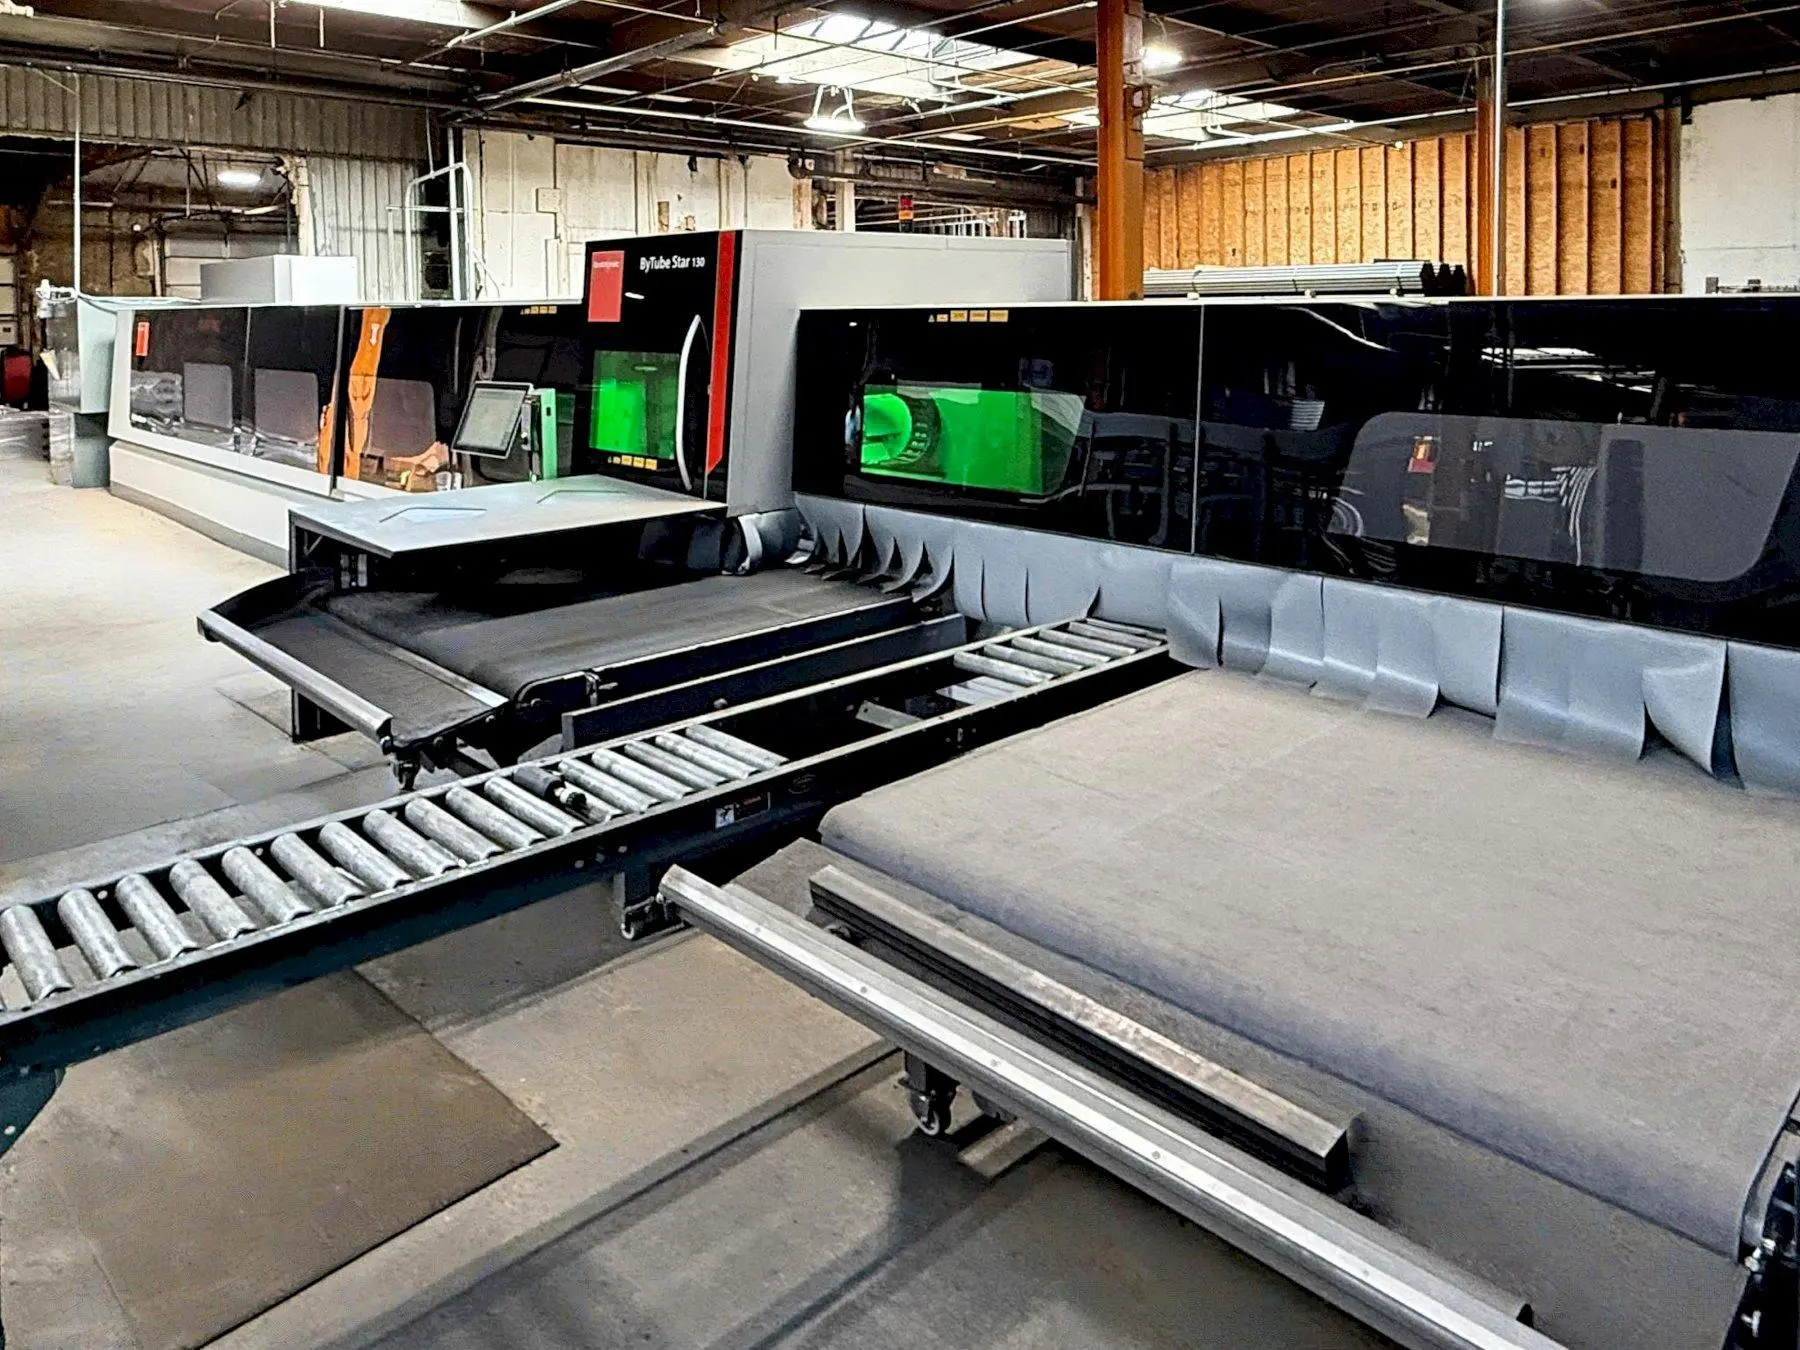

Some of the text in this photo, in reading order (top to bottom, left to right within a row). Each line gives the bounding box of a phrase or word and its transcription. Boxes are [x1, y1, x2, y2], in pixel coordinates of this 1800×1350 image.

[639, 254, 705, 274] ByTube Star 130
